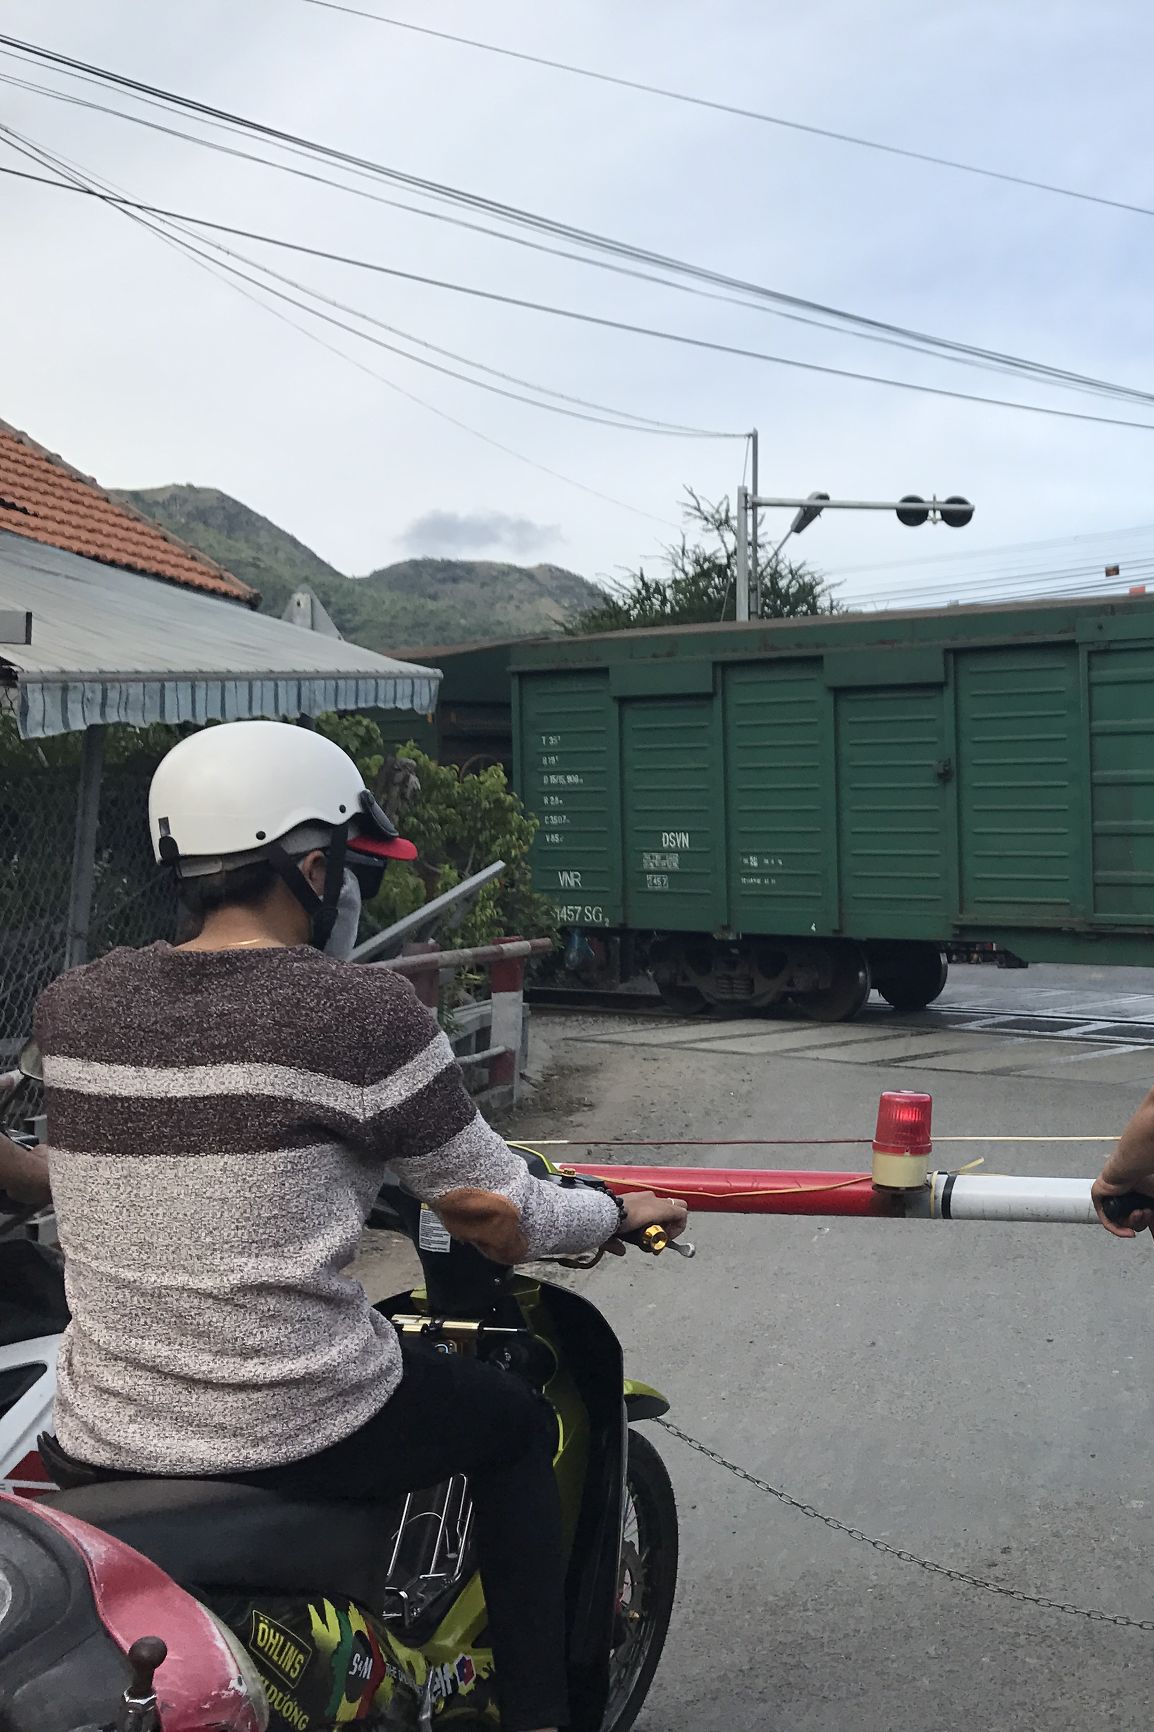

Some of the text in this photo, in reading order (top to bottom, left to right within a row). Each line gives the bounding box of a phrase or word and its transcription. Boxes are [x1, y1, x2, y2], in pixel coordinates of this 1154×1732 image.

[662, 832, 690, 848] DSVN
[558, 871, 582, 888] VNR
[551, 905, 582, 921] 1457
